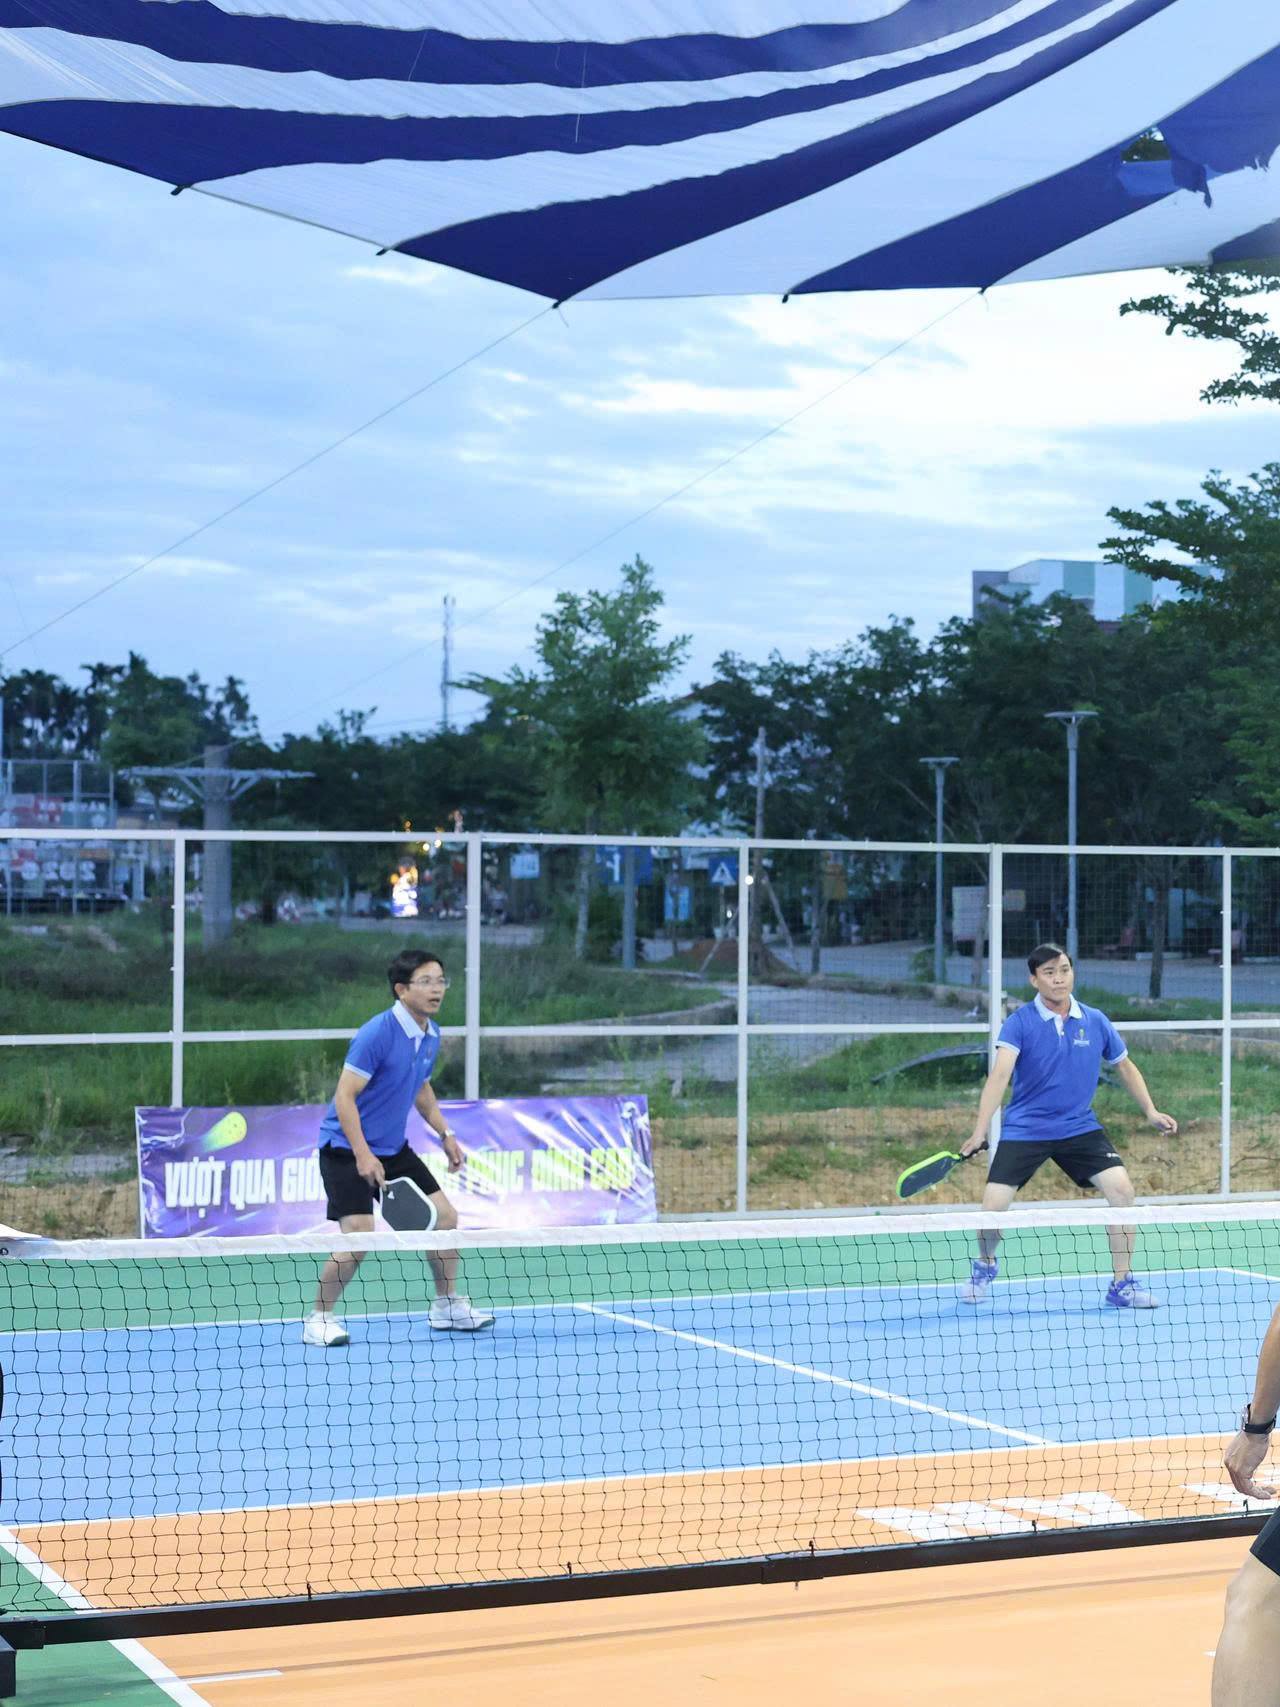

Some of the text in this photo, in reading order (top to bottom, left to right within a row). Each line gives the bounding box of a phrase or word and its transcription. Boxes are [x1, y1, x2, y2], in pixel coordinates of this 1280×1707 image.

[164, 1155, 227, 1219] VƯỢT
[229, 1157, 277, 1211] QUA
[281, 1148, 328, 1203] GIỚ
